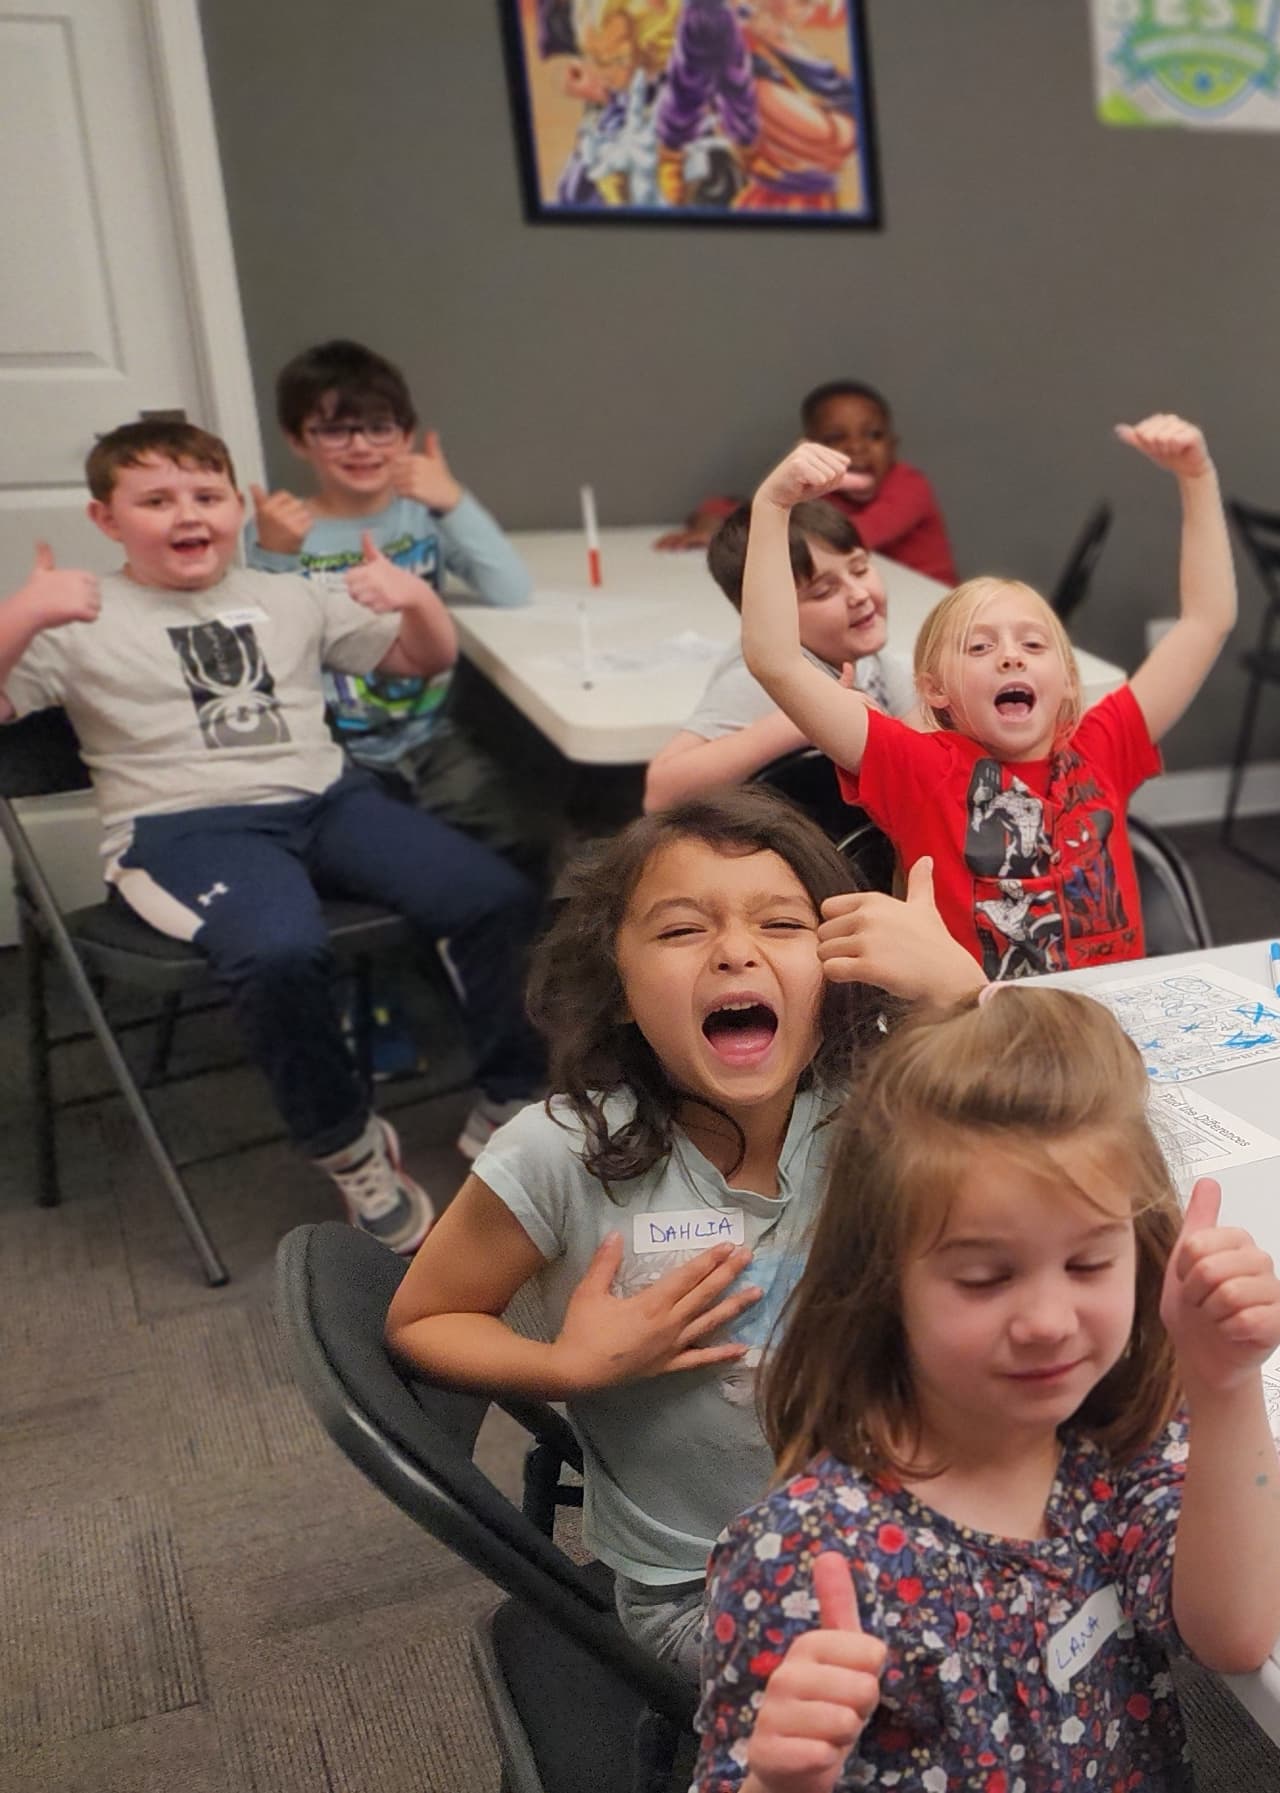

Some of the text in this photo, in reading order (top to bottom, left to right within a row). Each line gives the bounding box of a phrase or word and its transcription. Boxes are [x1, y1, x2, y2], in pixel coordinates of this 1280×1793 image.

[1158, 1092, 1251, 1148] Find the Differences
[649, 1216, 733, 1243] DAHLIA
[1055, 1615, 1099, 1670] LANA
